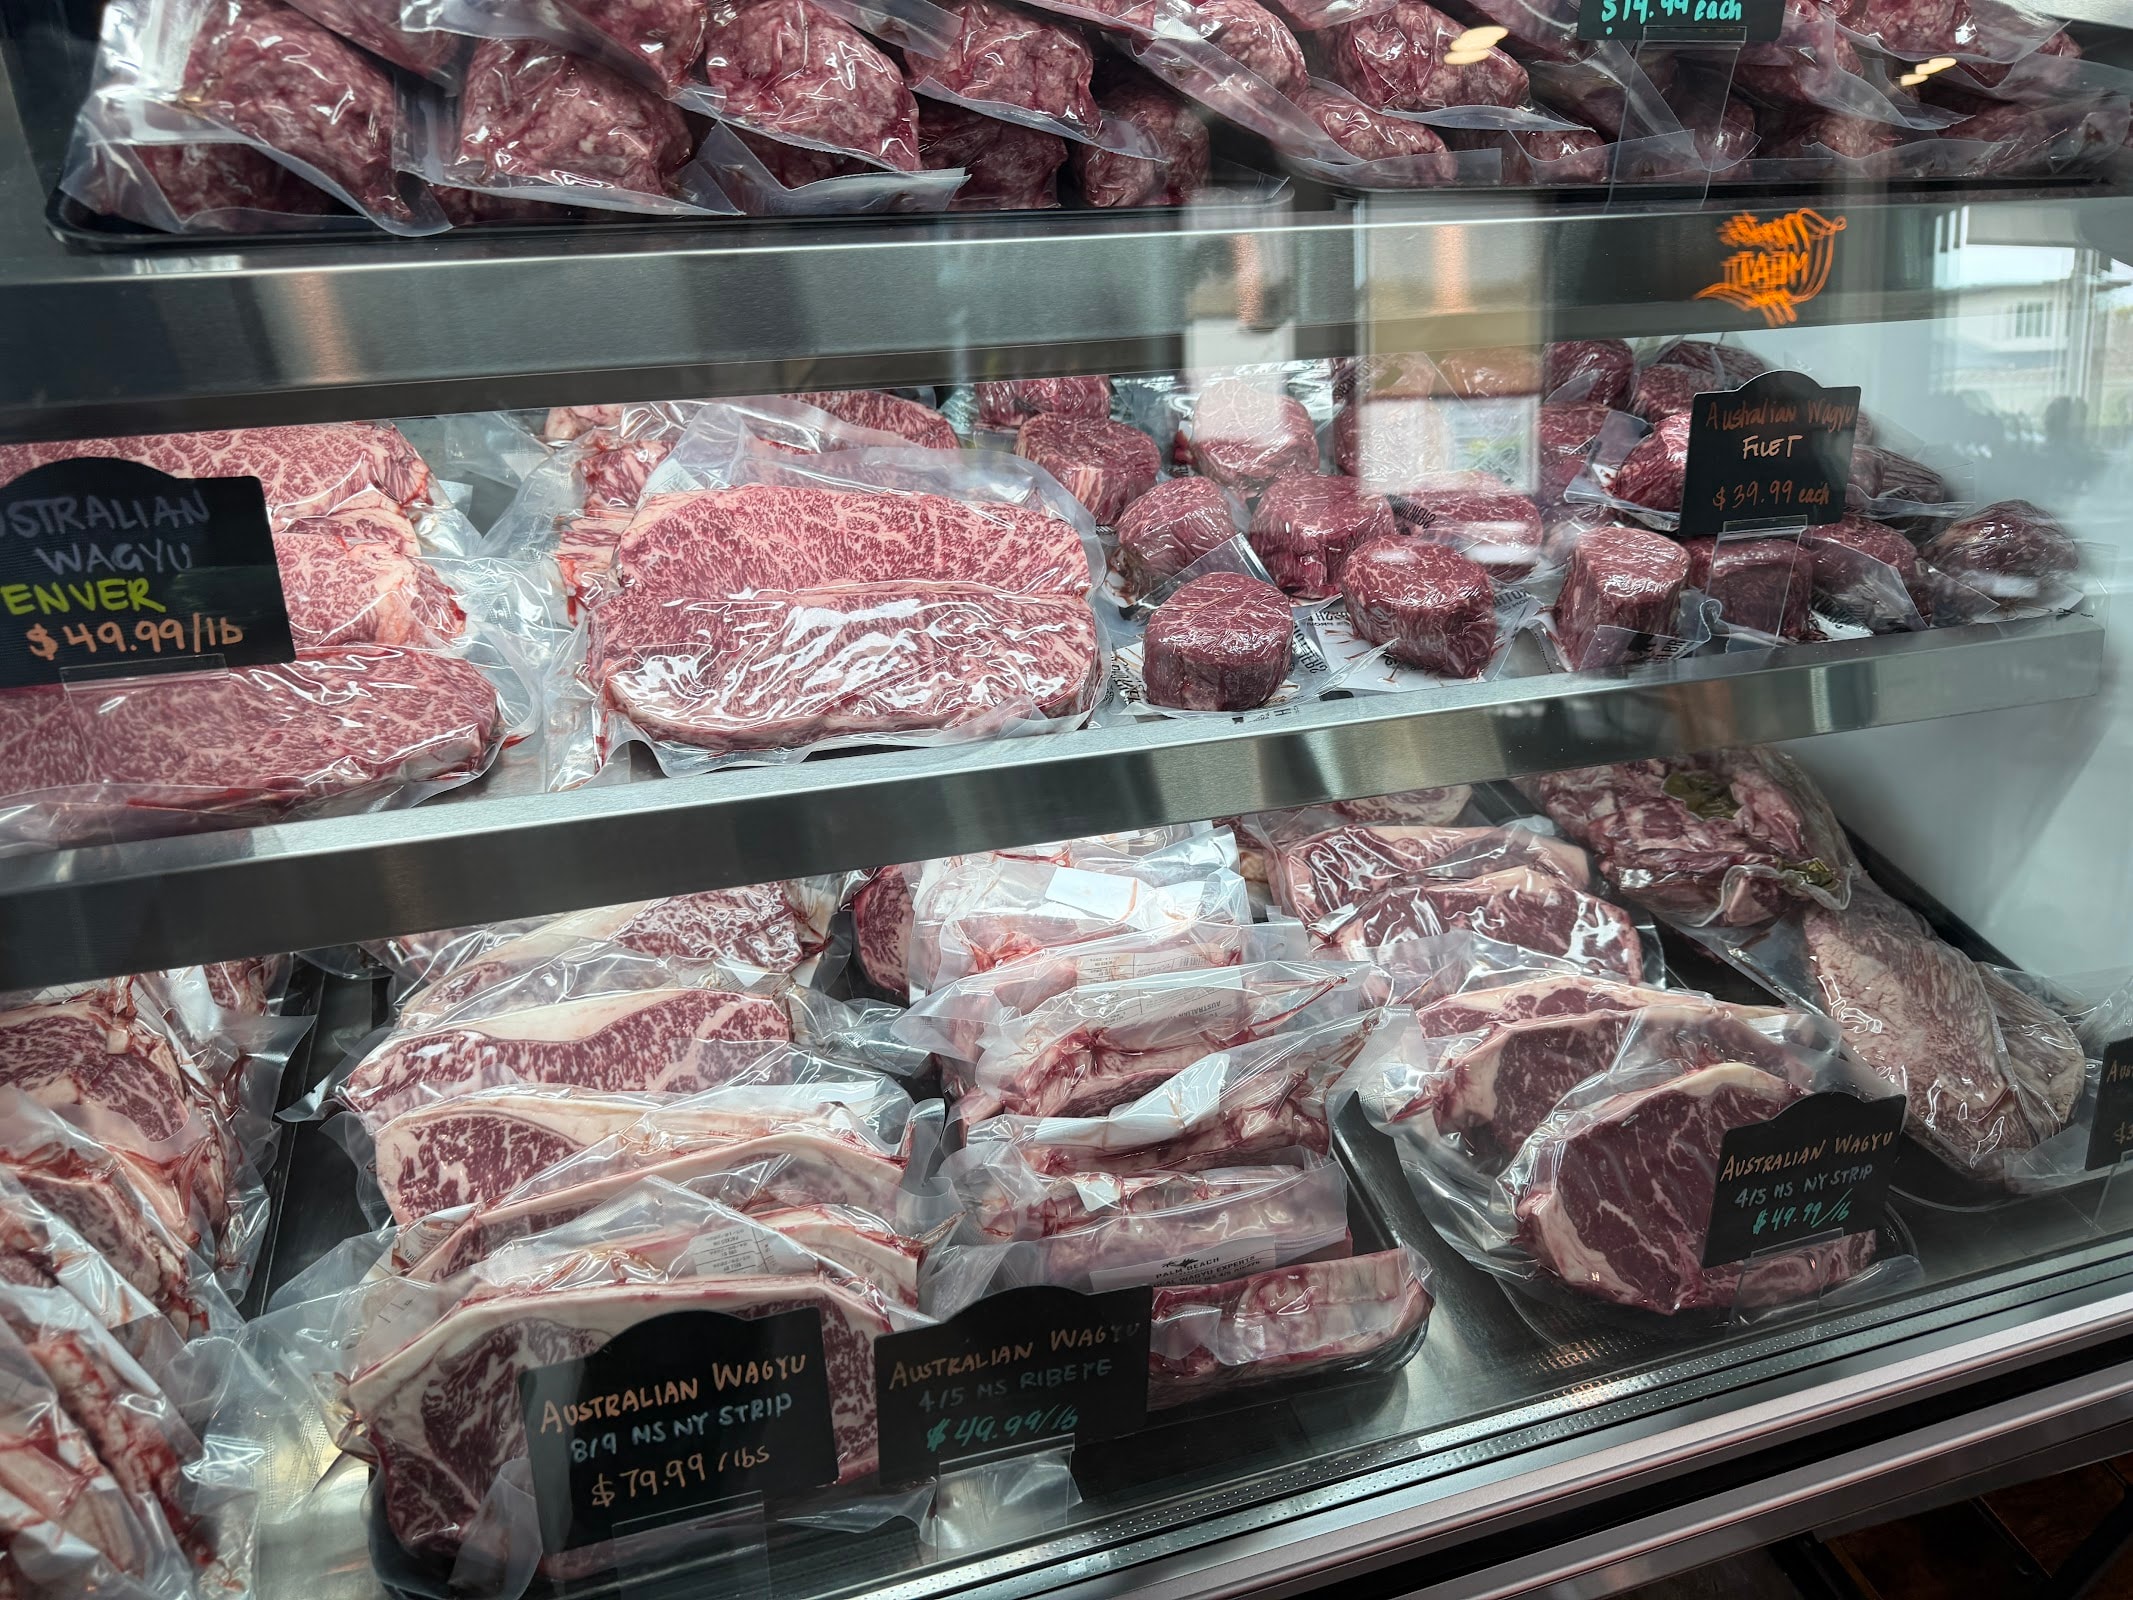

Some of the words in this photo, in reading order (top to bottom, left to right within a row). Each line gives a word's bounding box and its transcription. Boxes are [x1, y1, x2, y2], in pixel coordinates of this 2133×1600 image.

[1694, 0, 1742, 21] each
[1712, 479, 1793, 511] $39.99
[1798, 483, 1831, 505] each
[34, 538, 192, 575] WAGYU
[0, 577, 166, 616] ENVER
[25, 611, 244, 661] $49.99/lb
[1720, 1140, 1827, 1182] AUSTRALIAN
[1835, 1131, 1893, 1154] WAGYU
[1804, 1173, 1829, 1193] NY
[1830, 1164, 1873, 1186] STRIP
[1155, 1267, 1184, 1280] PALM
[1186, 1257, 1220, 1271] BEACH
[889, 1341, 1034, 1390] AUSTRALIAN
[1050, 1323, 1140, 1351] WAGYU
[540, 1377, 698, 1435] AUSTRALIAN
[712, 1354, 807, 1392] WAGYU
[977, 1379, 1008, 1399] MS
[1020, 1359, 1112, 1389] RIBEYE
[632, 1420, 667, 1446] MS
[673, 1411, 710, 1439] NY
[718, 1393, 793, 1426] STRIP
